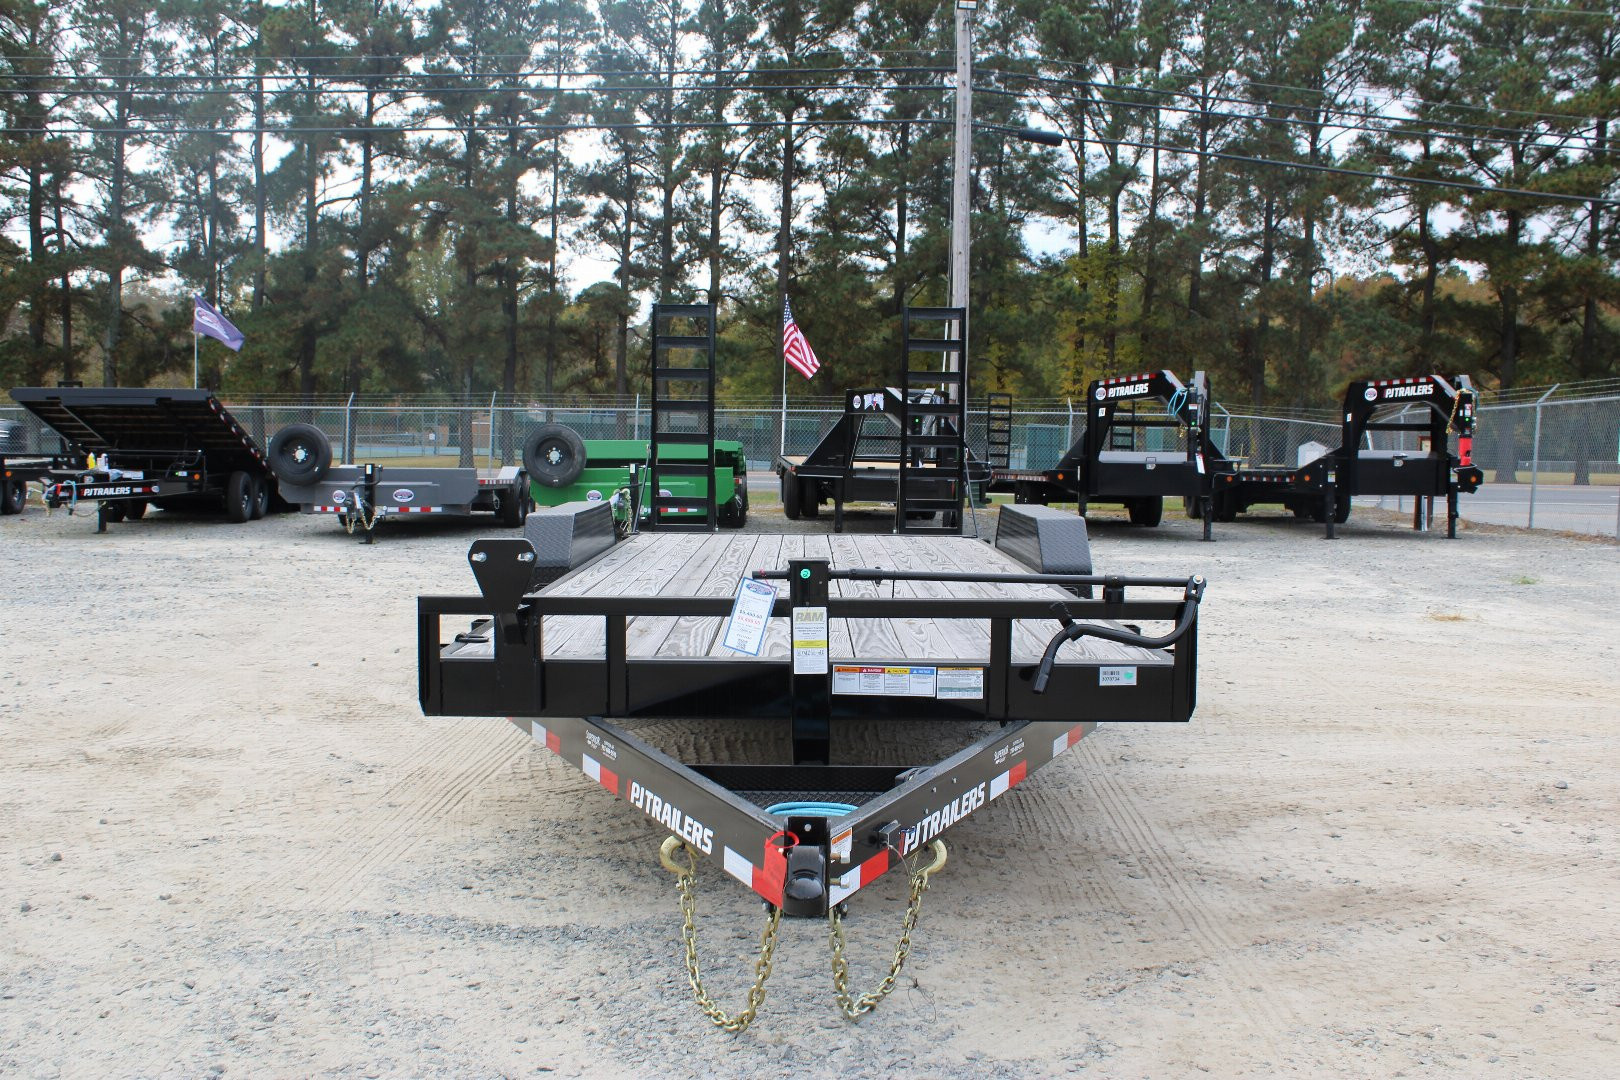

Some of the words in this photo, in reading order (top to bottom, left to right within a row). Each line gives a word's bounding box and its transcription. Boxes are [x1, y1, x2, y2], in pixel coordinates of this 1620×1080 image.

[1115, 383, 1149, 397] TRAILERS
[1394, 384, 1434, 398] TRAILERS
[93, 486, 131, 496] TRAILERS
[795, 611, 824, 622] RAM
[921, 781, 986, 844] TRAILERS
[644, 789, 714, 856] TRAILERS
